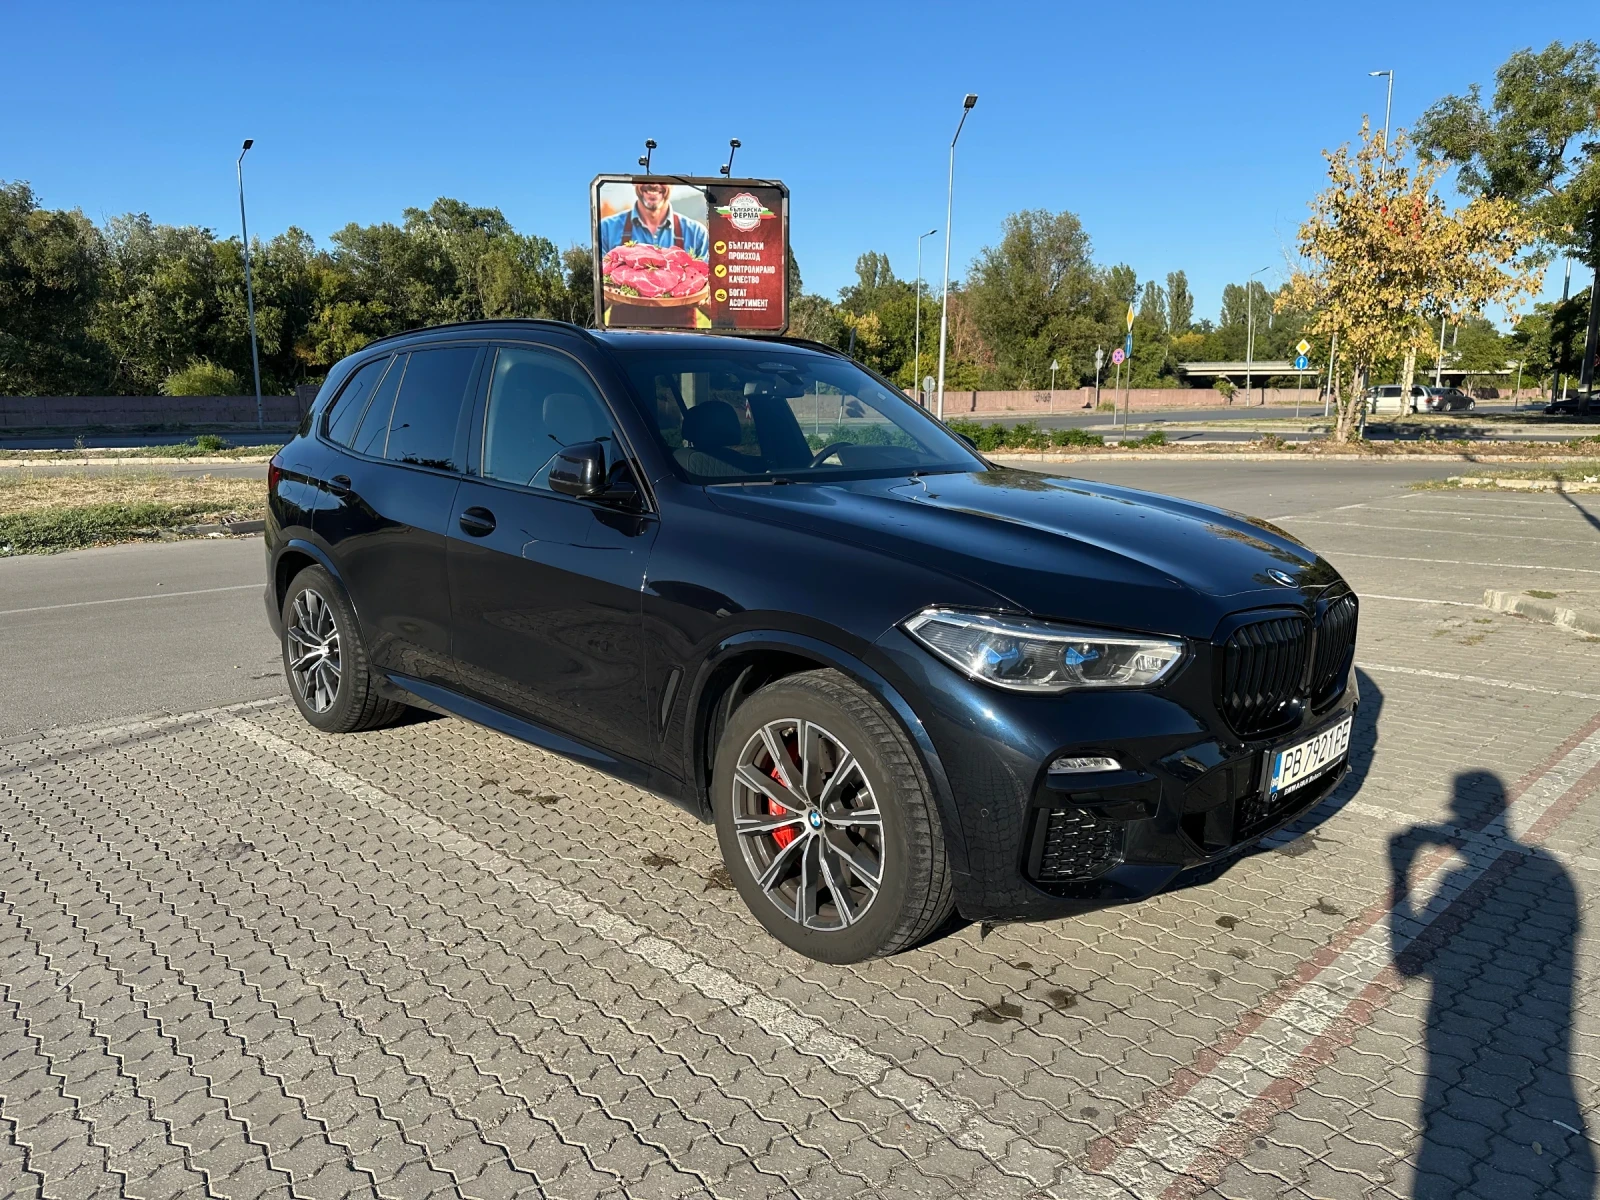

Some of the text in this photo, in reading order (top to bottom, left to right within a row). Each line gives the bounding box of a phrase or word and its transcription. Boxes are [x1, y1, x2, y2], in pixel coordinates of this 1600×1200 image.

[728, 241, 764, 250] БЪЛГАРСКИ
[728, 252, 761, 261] ПРОИЗХОД
[728, 265, 776, 274] КОНТРОЛИРАНО
[728, 275, 760, 284] КАЧЕСТВО
[729, 288, 747, 297] БОГАТ
[729, 298, 769, 307] АСОРТИМЕНТ
